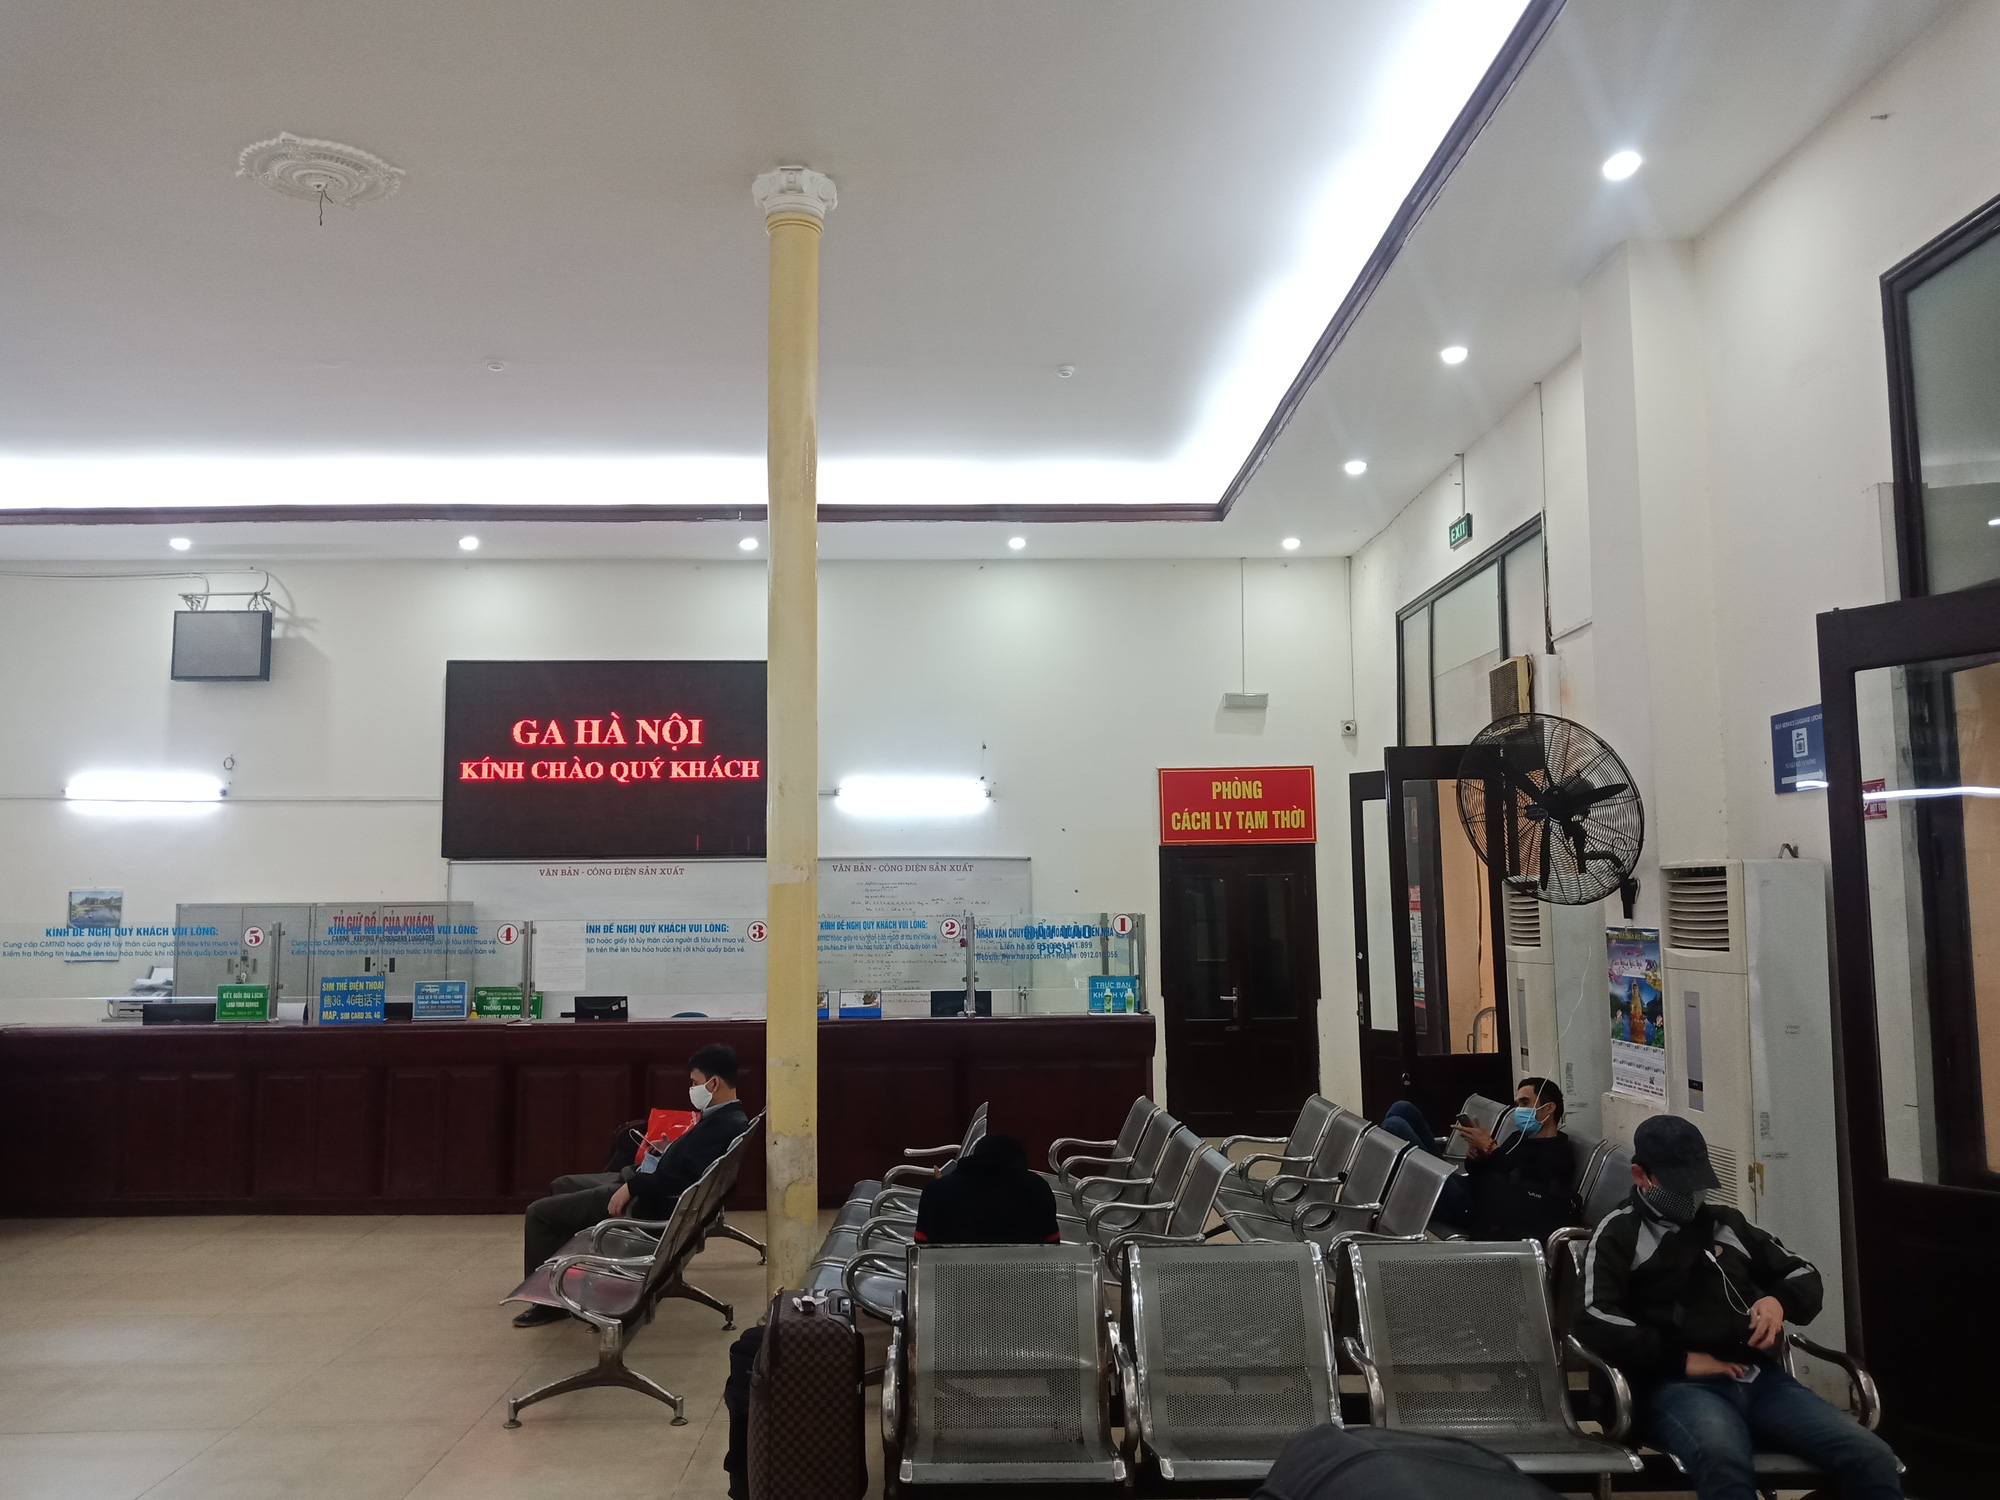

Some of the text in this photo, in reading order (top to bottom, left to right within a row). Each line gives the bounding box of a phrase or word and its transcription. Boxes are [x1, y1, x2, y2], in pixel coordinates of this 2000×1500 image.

[1451, 520, 1466, 543] EXIT
[512, 711, 703, 751] GA HÀ NỘI
[459, 755, 760, 783] KÍNH CHÀO QUÝ KHÁCH
[1211, 776, 1263, 799] PHÒNG
[1171, 805, 1306, 833] CÁCH LY TẠM THỜI
[539, 865, 685, 877] VĂN BẢN CÔNG ĐIỆN SẢN XUẤT
[832, 861, 975, 873] VĂN BẢN CÔNG ĐIỆN SẢN XUẤT
[437, 926, 450, 934] VUI
[454, 924, 478, 934] LÒNG:
[586, 922, 730, 935] ÍNH ĐỀ NGHỊ QUÝ KHÁCH VUI LÒNG:
[846, 920, 861, 931] NGHỊ
[863, 919, 875, 930] QUÝ
[877, 919, 896, 930] KHÁCH
[898, 920, 910, 929] VUI
[910, 918, 928, 929] LÒNG:
[945, 921, 957, 936] 2
[1120, 917, 1127, 931] 1
[46, 926, 69, 937] KÍNH
[88, 927, 111, 938] NGHỊ
[115, 926, 134, 937] QUÝ
[136, 925, 168, 936] KHÁCH
[172, 926, 187, 936] VUI
[190, 925, 218, 936] LÒNG:
[248, 930, 260, 945] 5
[500, 927, 512, 942] 4
[752, 924, 764, 939] 3
[1040, 943, 1073, 956] PUSH
[322, 982, 335, 991] SIM
[336, 979, 348, 991] THẺ
[366, 981, 384, 991] THOẠI
[350, 1012, 364, 1020] CARD
[374, 1011, 381, 1019] 4G
